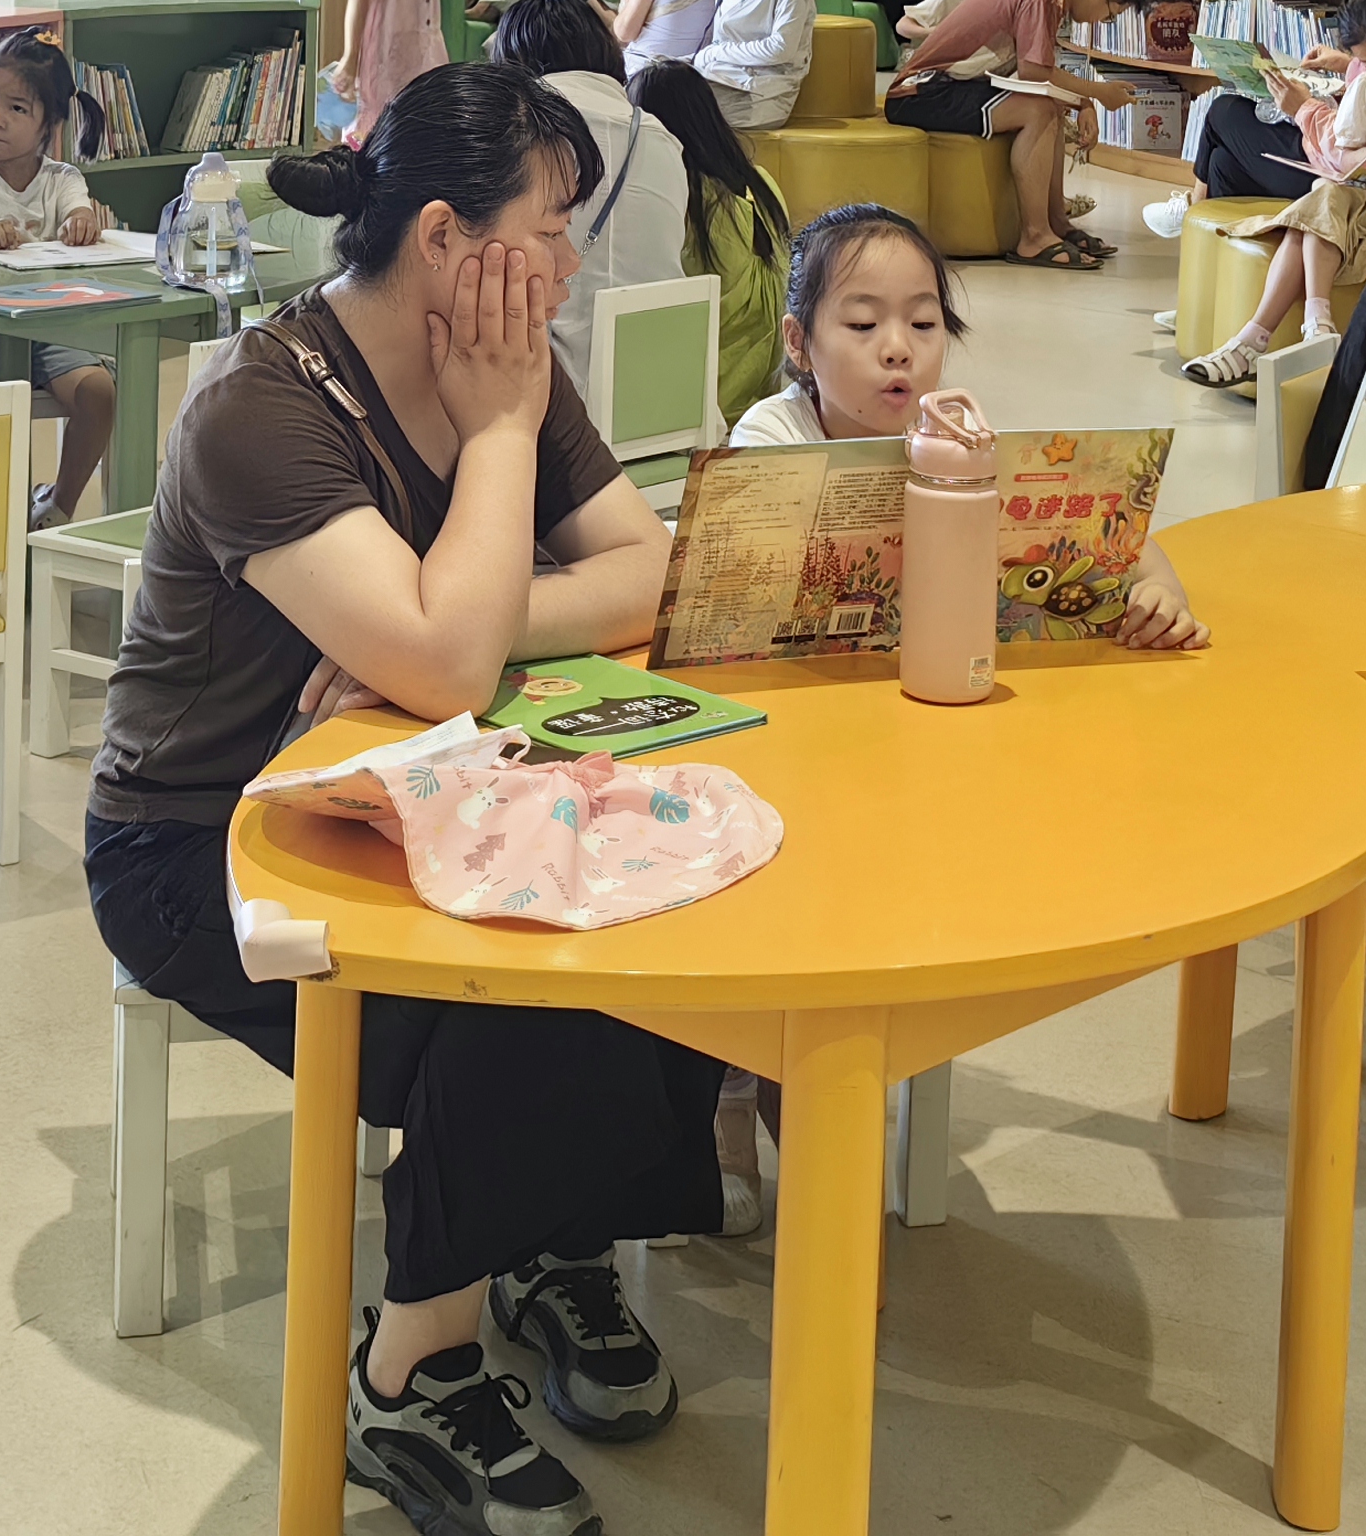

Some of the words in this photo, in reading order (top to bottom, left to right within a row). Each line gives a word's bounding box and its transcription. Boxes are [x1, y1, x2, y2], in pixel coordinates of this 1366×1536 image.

[999, 492, 1123, 521] 龟迷路了
[541, 862, 570, 901] Rabbit
